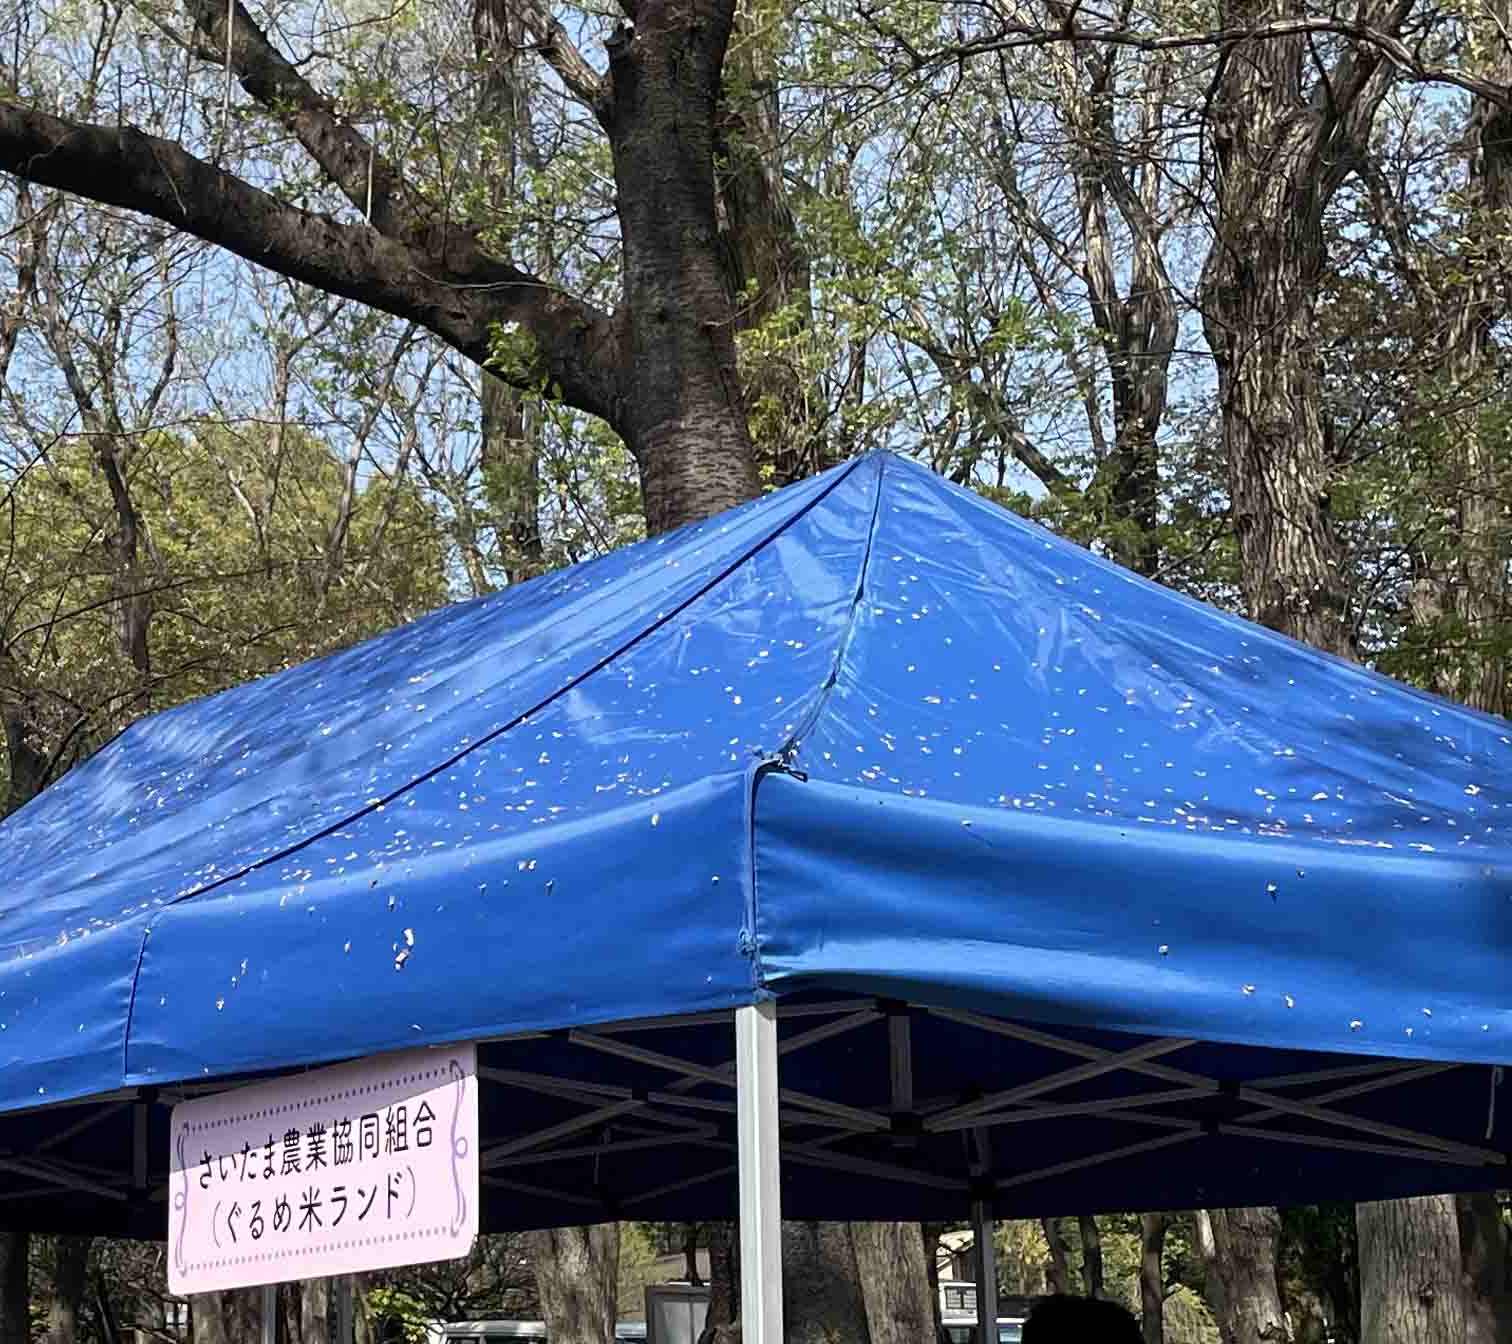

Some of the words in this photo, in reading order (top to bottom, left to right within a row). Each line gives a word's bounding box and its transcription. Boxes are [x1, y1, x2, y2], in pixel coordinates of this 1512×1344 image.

[199, 1100, 436, 1189] さいたま農業協同組合
